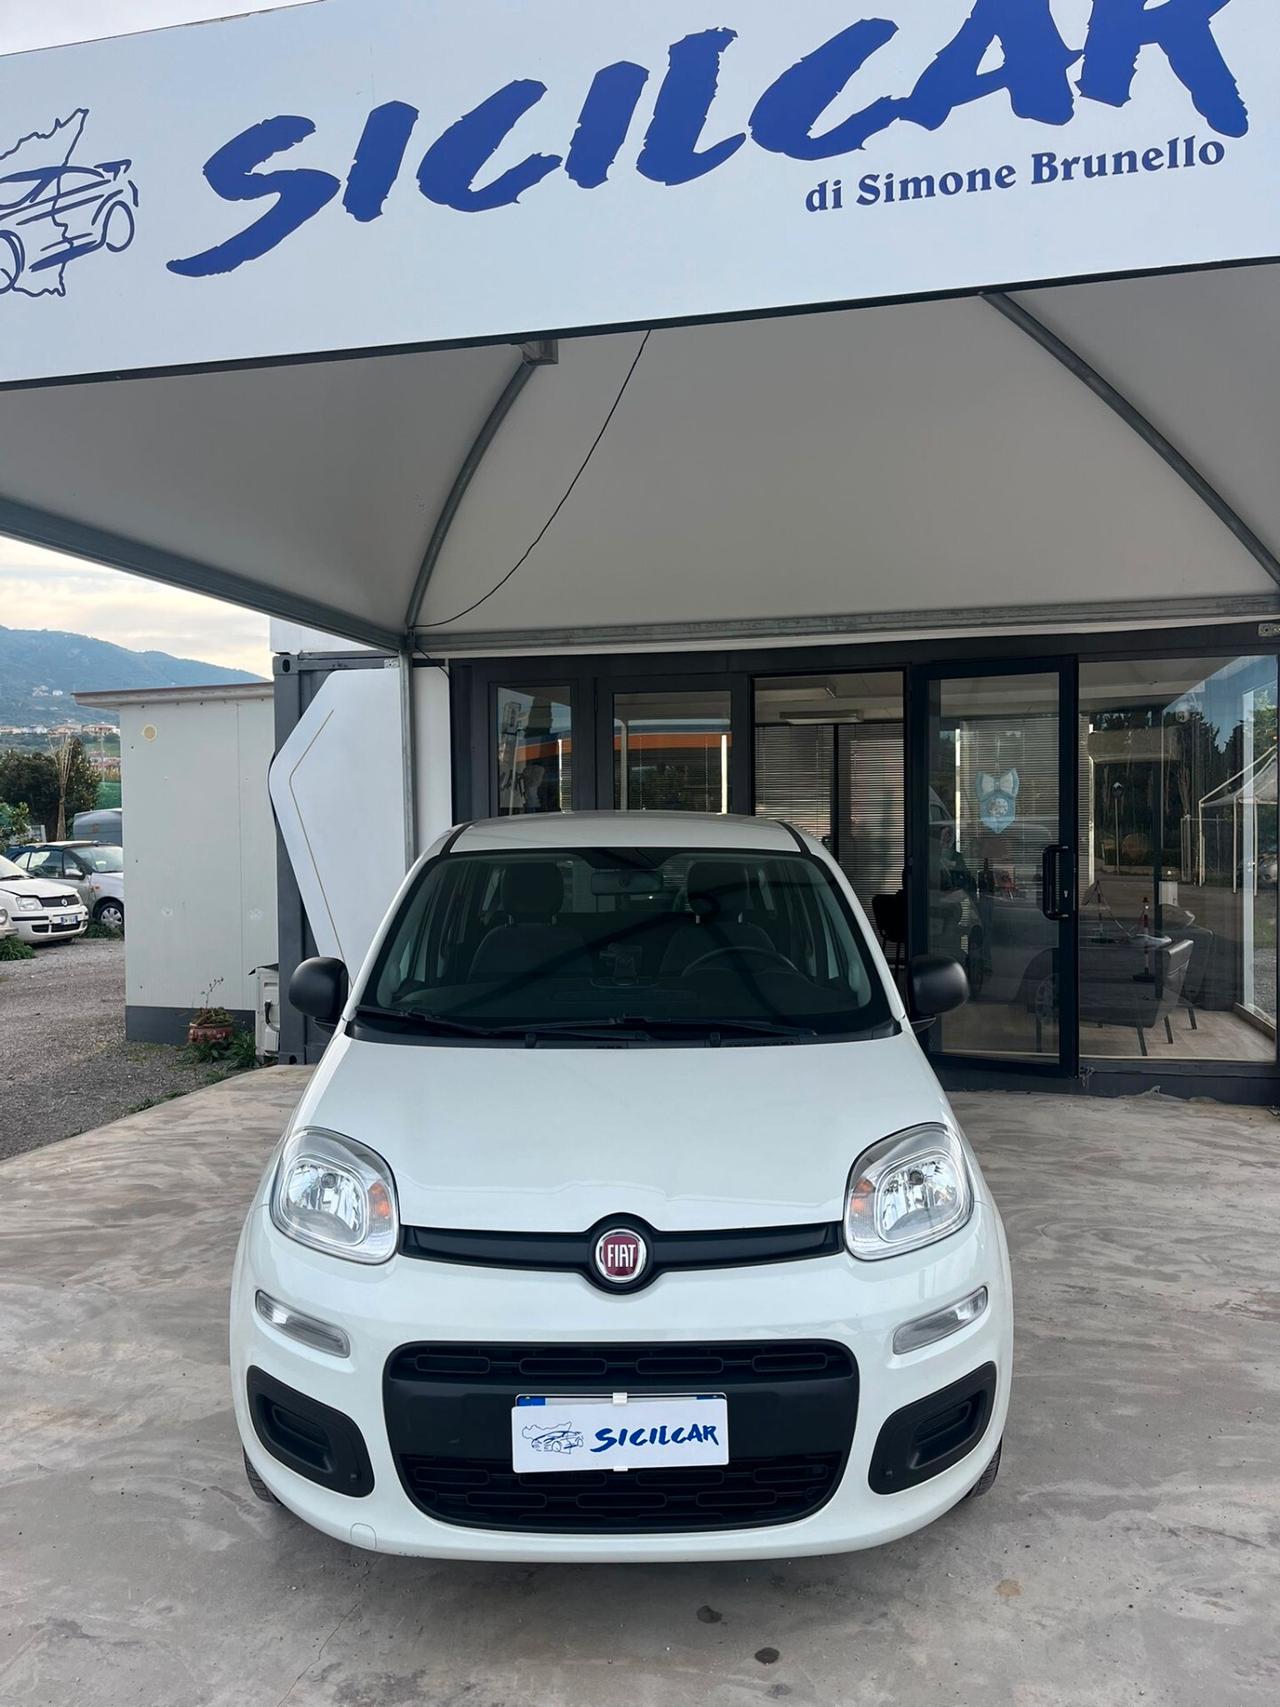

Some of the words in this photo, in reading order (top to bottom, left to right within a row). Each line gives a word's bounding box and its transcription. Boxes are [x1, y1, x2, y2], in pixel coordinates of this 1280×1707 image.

[166, 0, 1248, 277] SICILCAR
[805, 180, 842, 212] di
[855, 165, 1016, 206] Simone
[1031, 135, 1225, 184] Brunello
[607, 1244, 637, 1268] FIAT
[590, 1423, 720, 1452] SICILCAR
